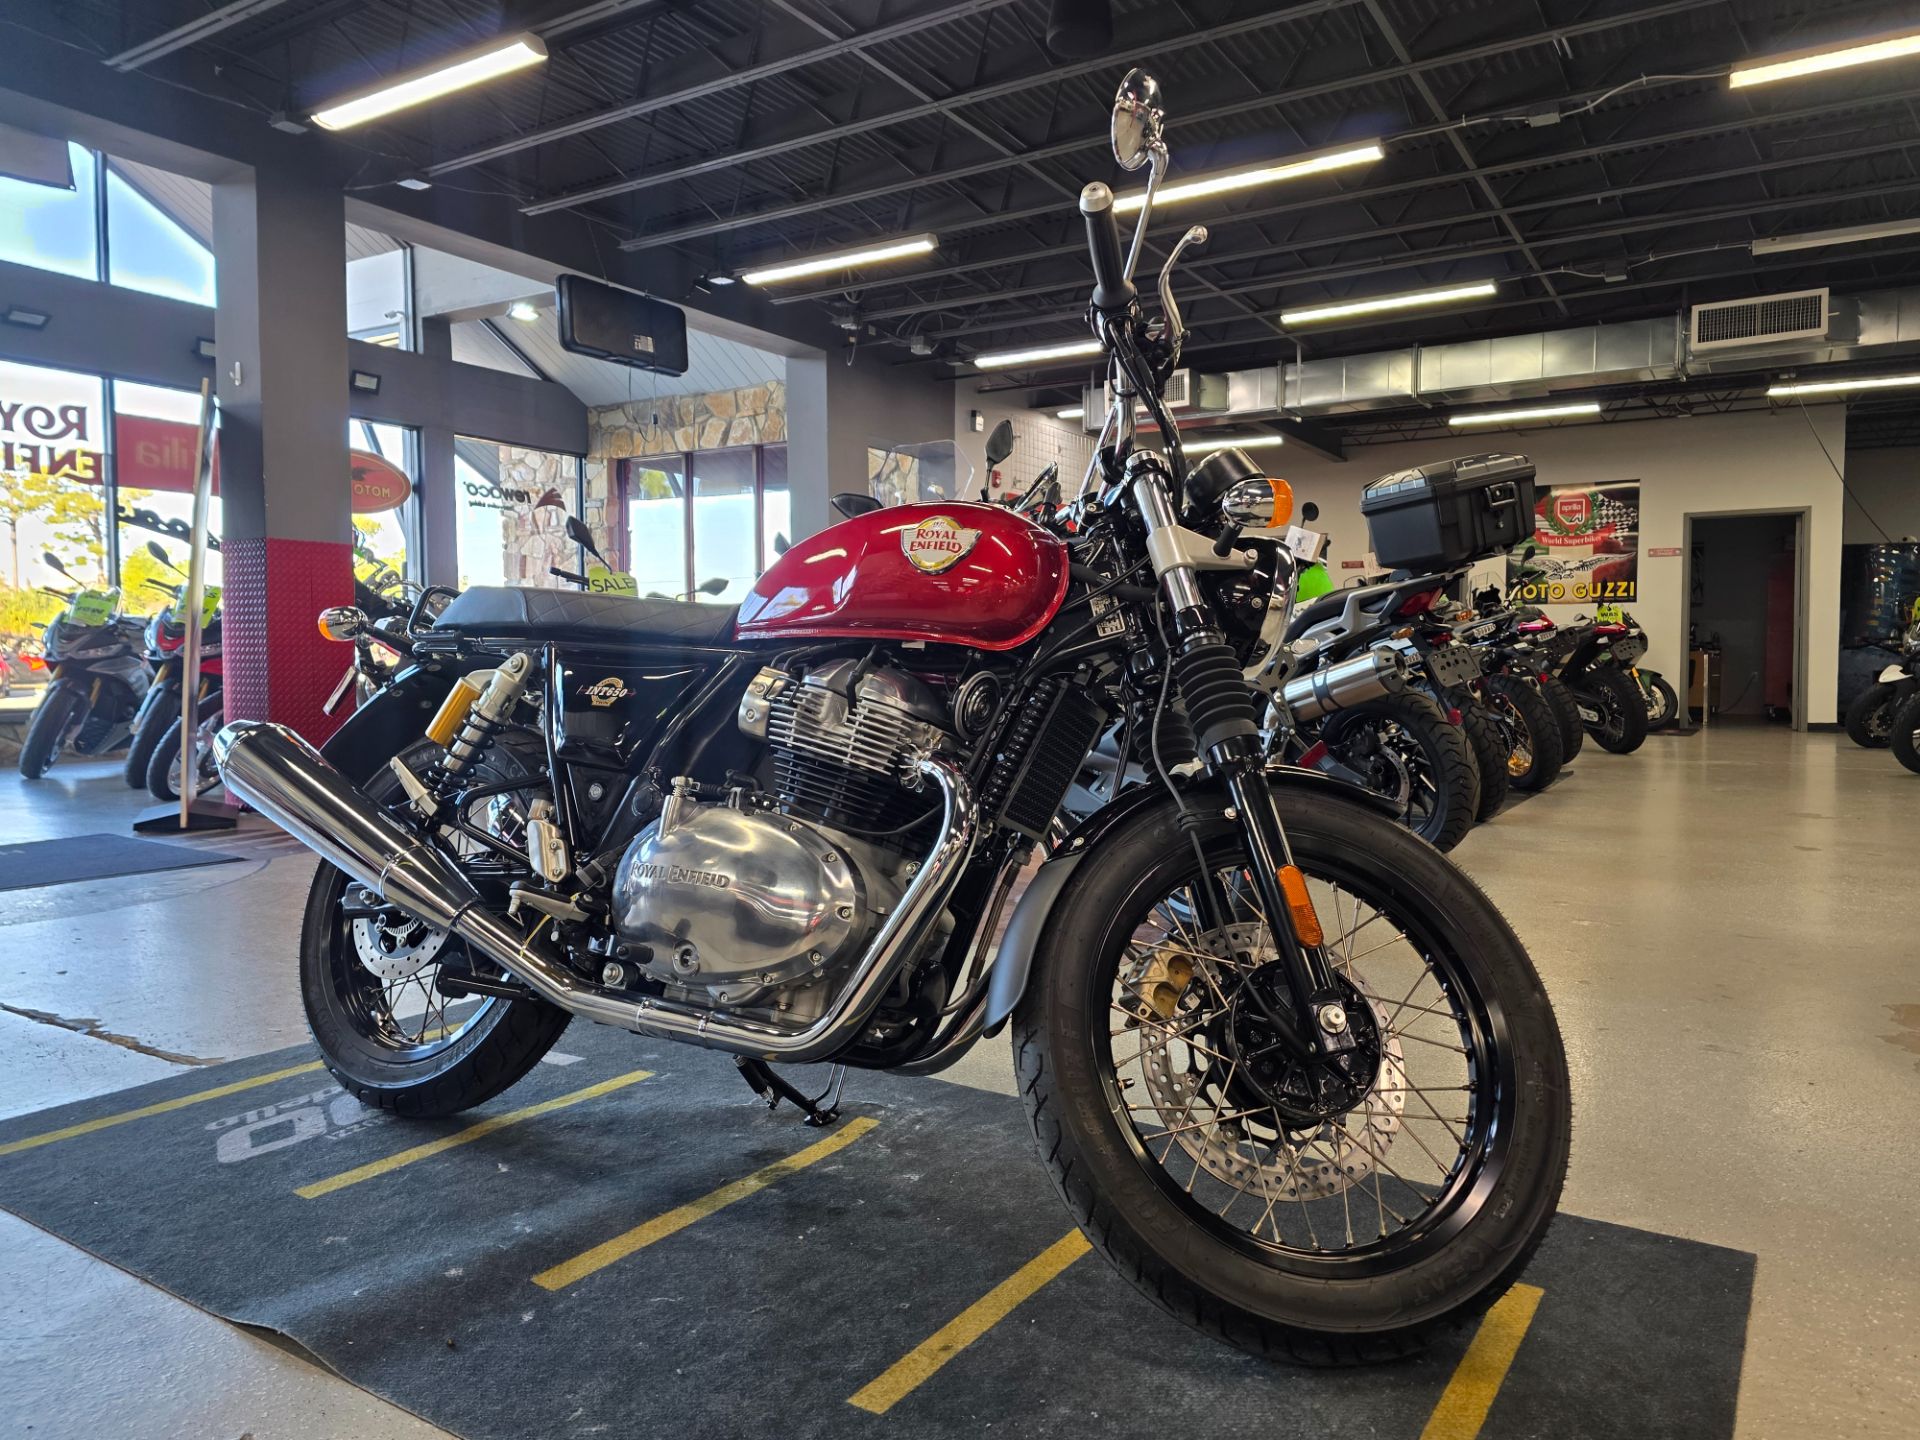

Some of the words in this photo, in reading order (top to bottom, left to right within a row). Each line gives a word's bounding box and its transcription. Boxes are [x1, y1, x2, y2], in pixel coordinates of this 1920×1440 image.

[916, 528, 958, 540] ROYAL
[1541, 536, 1562, 545] World
[909, 540, 963, 554] ENFIELD
[590, 576, 635, 594] SALE
[1516, 581, 1565, 599] OTO
[1573, 581, 1636, 599] GUZZI
[584, 685, 628, 698] INT650
[630, 860, 667, 881] ROYAL
[667, 864, 731, 888] ENFIELD
